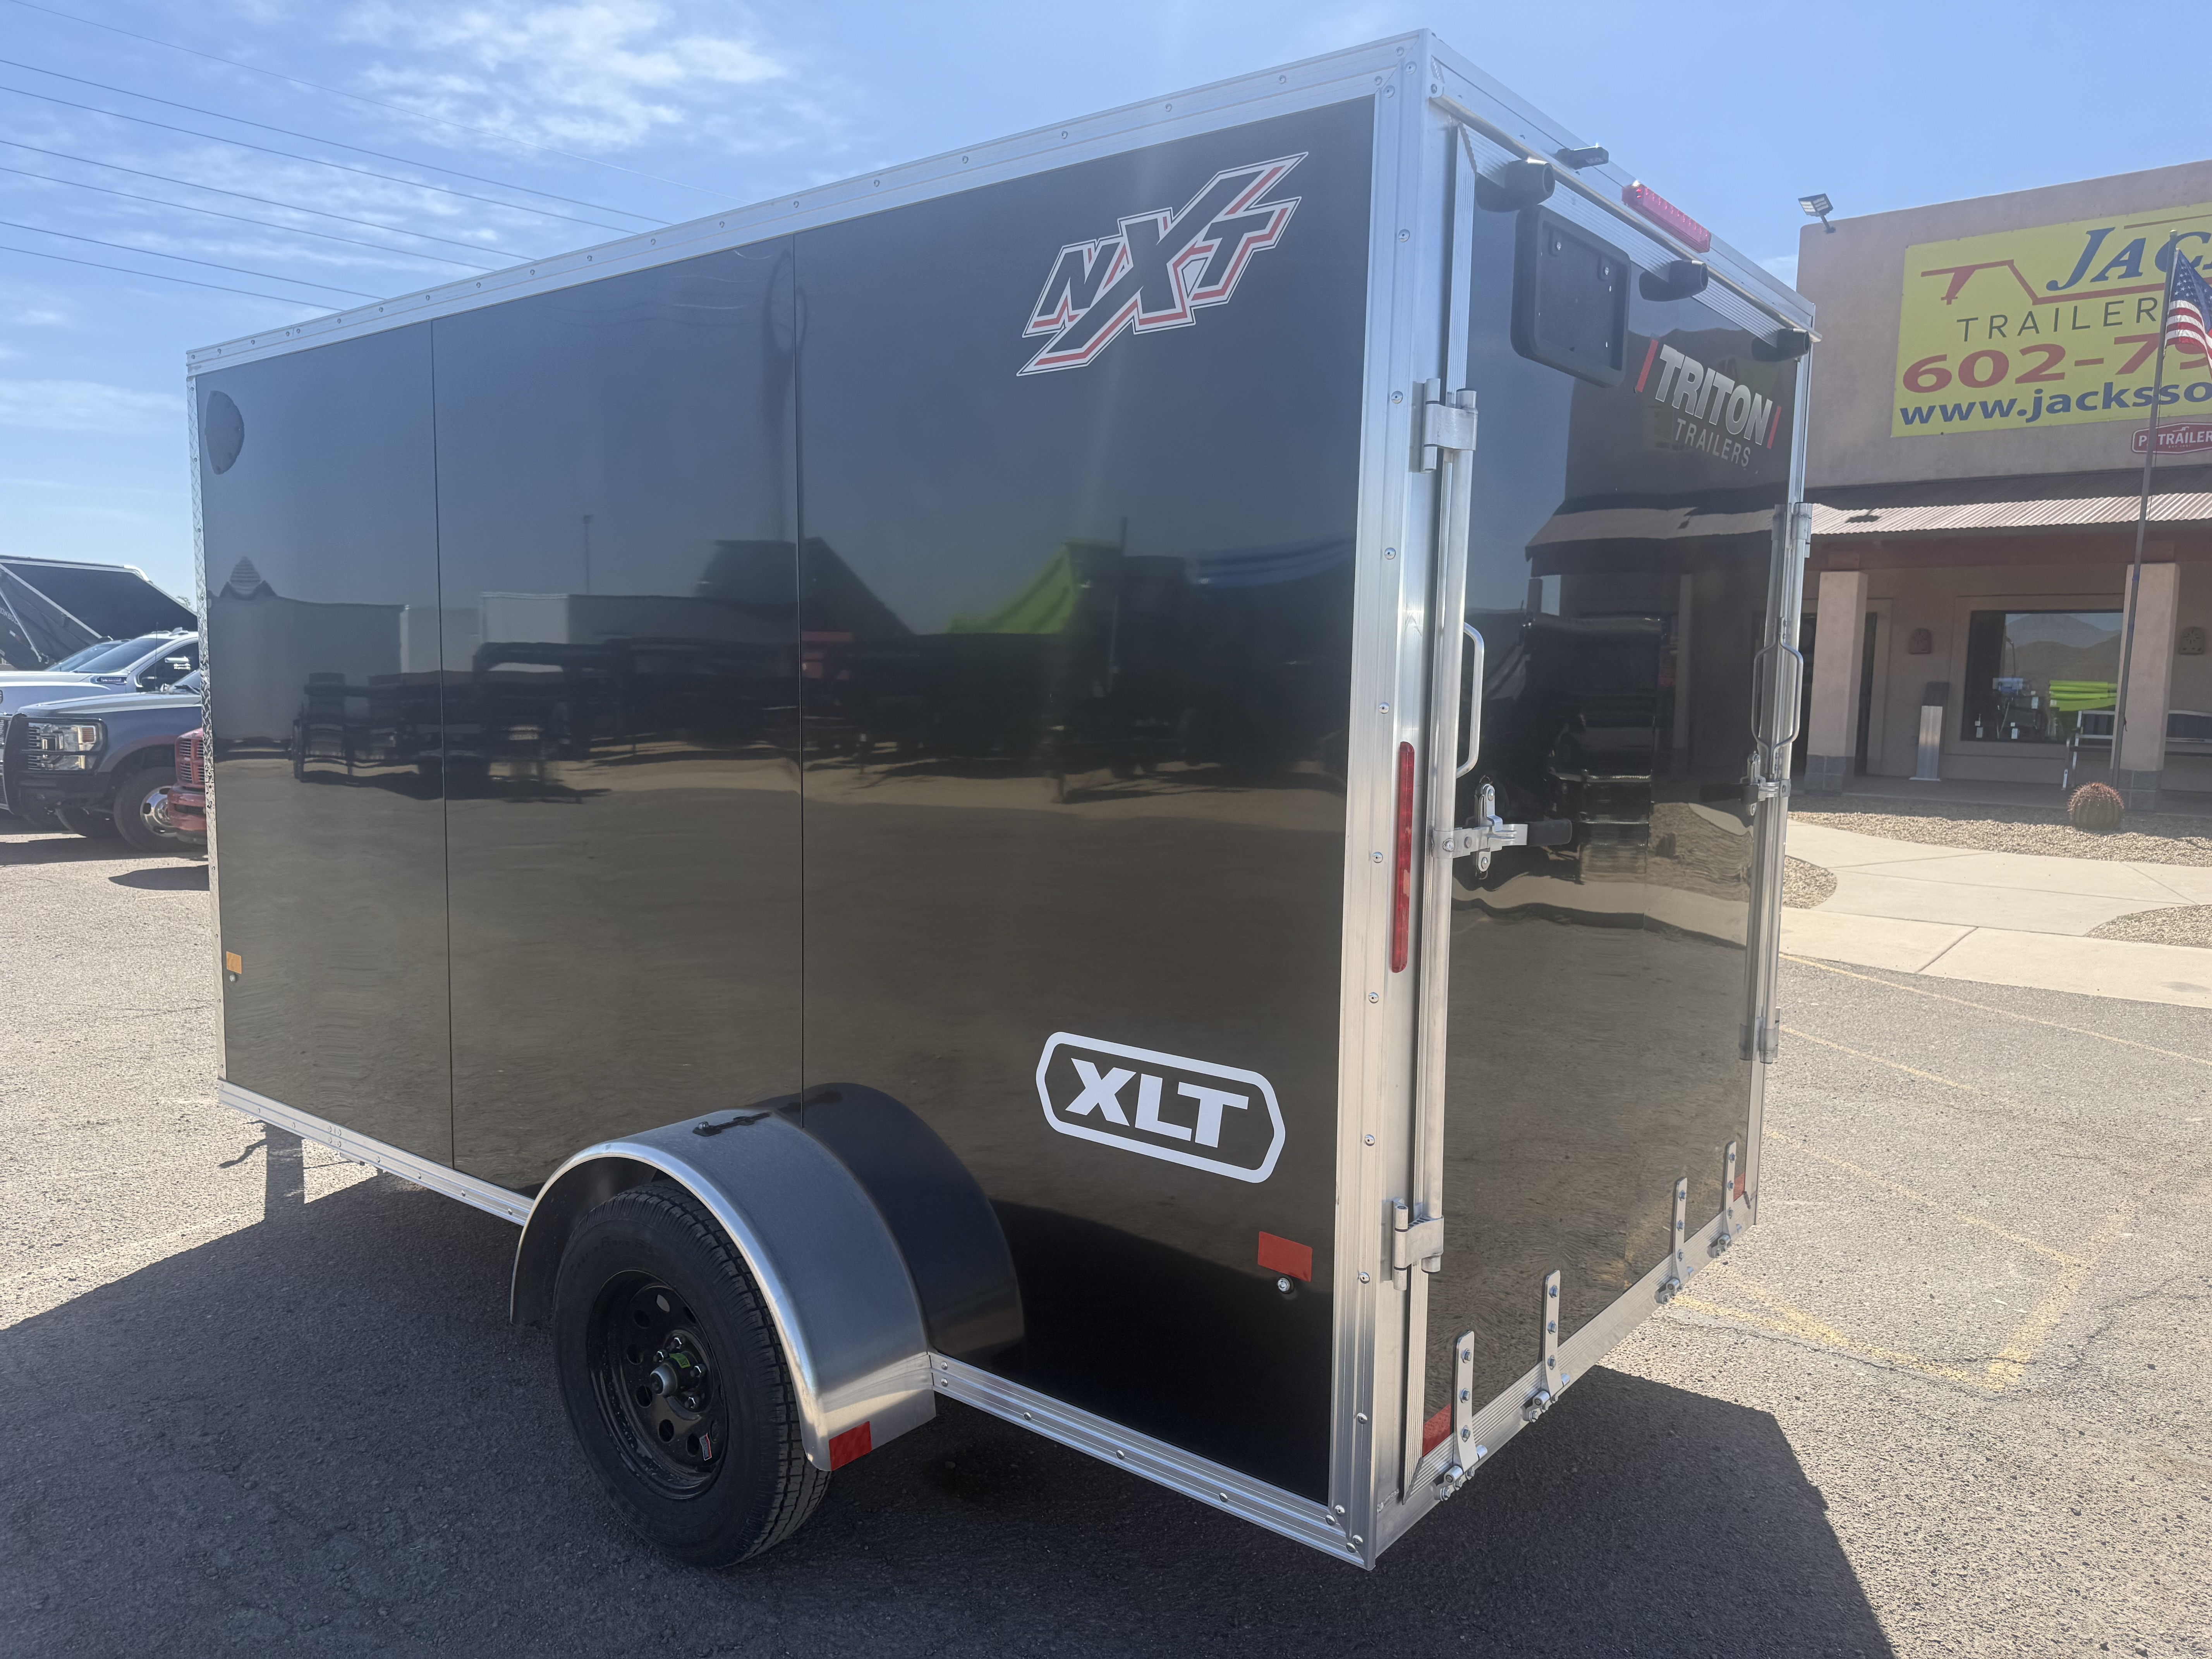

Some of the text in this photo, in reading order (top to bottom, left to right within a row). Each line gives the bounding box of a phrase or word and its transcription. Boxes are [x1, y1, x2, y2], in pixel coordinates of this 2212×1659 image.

[1017, 152, 1309, 376] NXT
[2045, 227, 2212, 291] JAC
[1656, 344, 1773, 445] TRITON
[1675, 418, 1751, 467] TRAILERS
[1065, 1058, 1249, 1148] XLT
